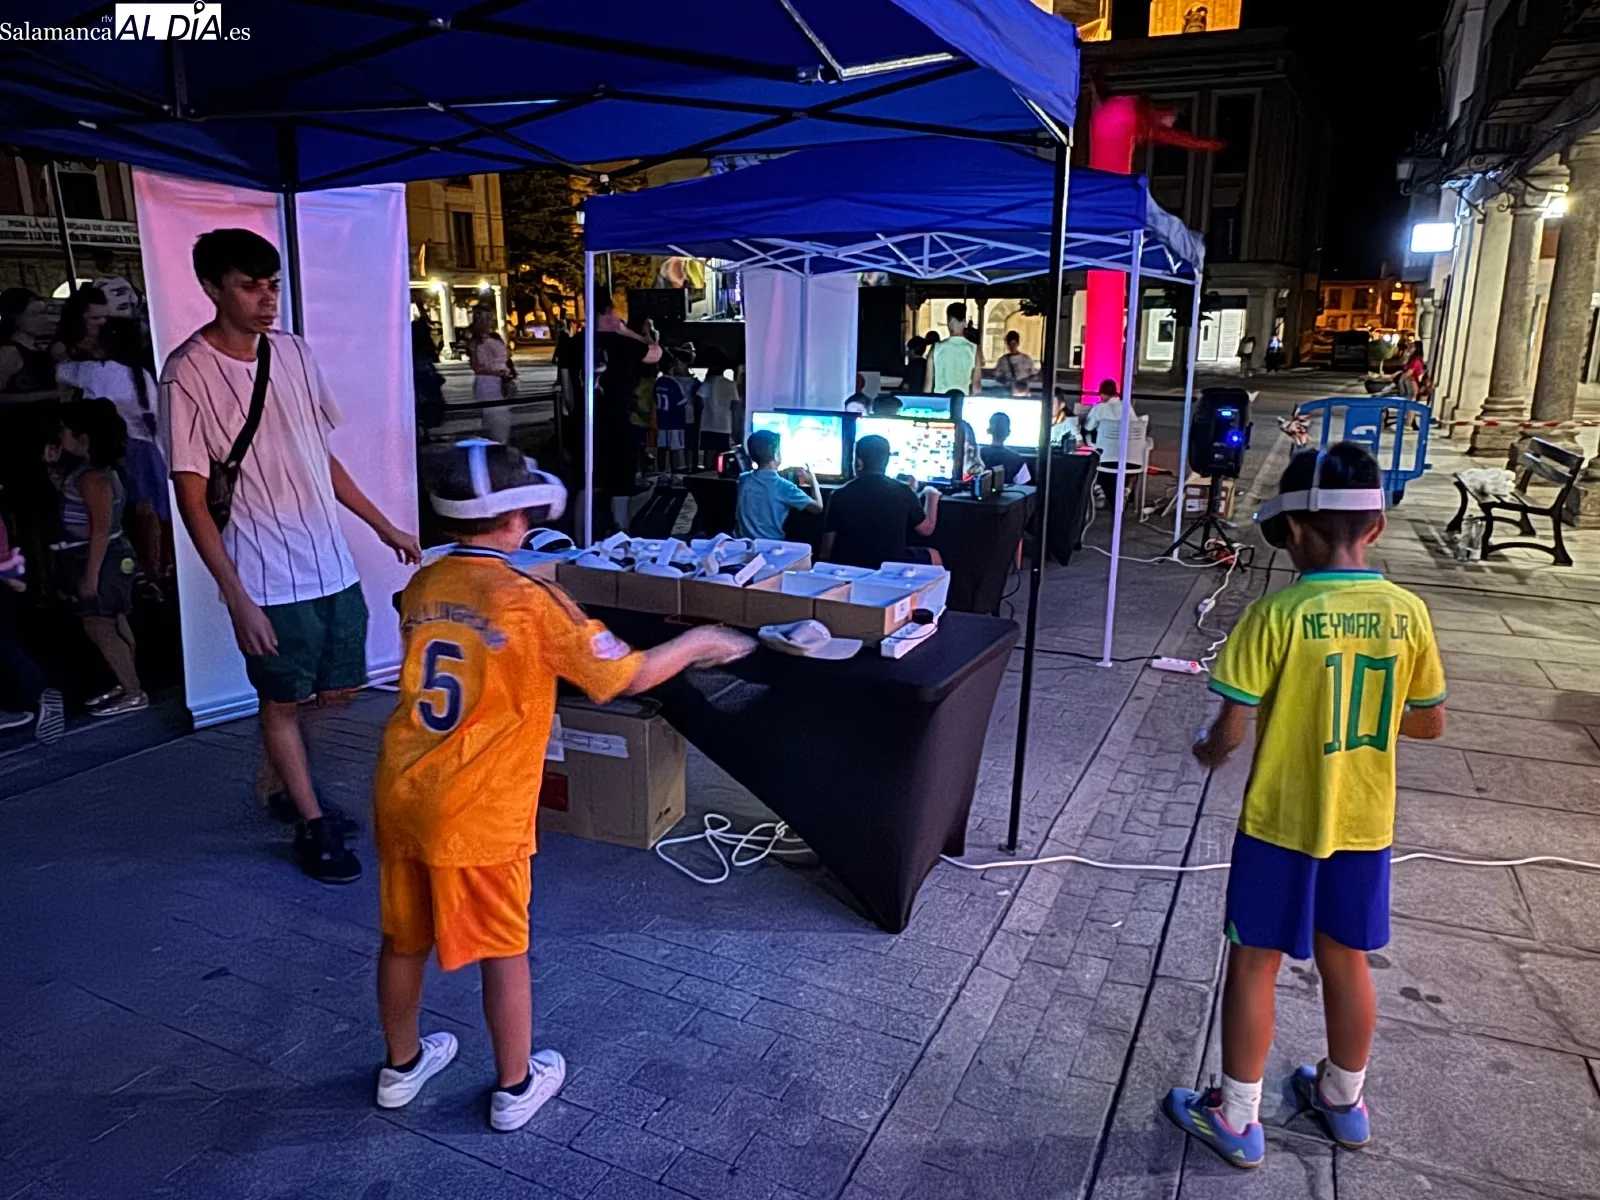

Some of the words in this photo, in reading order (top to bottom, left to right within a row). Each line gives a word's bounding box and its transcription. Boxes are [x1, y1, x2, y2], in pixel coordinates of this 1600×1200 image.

[1302, 612, 1381, 640] NEYMAR
[1390, 613, 1411, 640] JR
[416, 638, 465, 735] 5
[1324, 653, 1398, 755] 10
